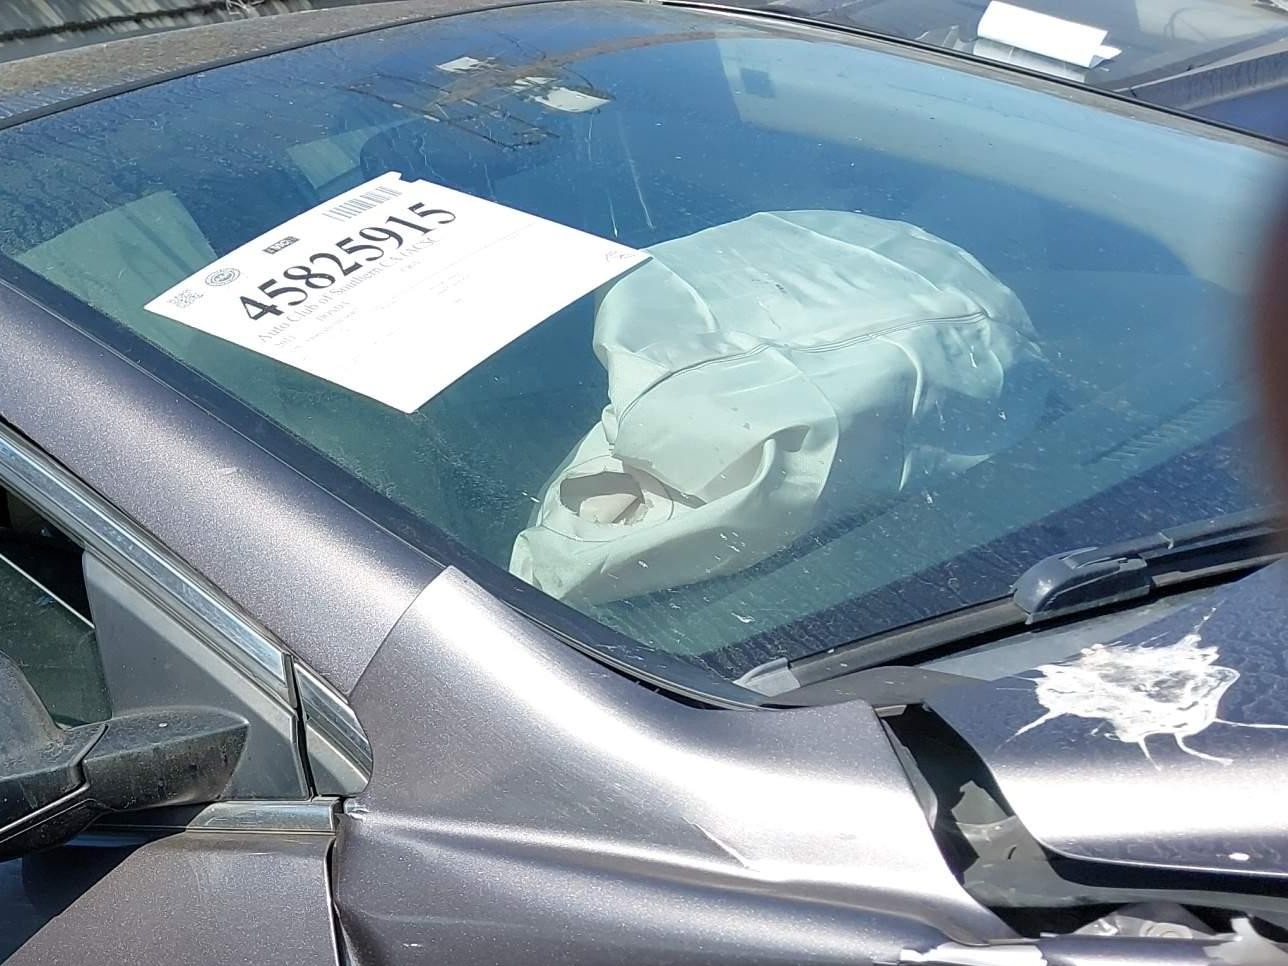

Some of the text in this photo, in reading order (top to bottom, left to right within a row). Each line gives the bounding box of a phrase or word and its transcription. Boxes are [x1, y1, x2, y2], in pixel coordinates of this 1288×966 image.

[239, 202, 456, 321] 45825915
[257, 322, 290, 343] Auto
[286, 303, 319, 323] Club
[318, 292, 333, 305] of
[329, 265, 384, 296] Southern
